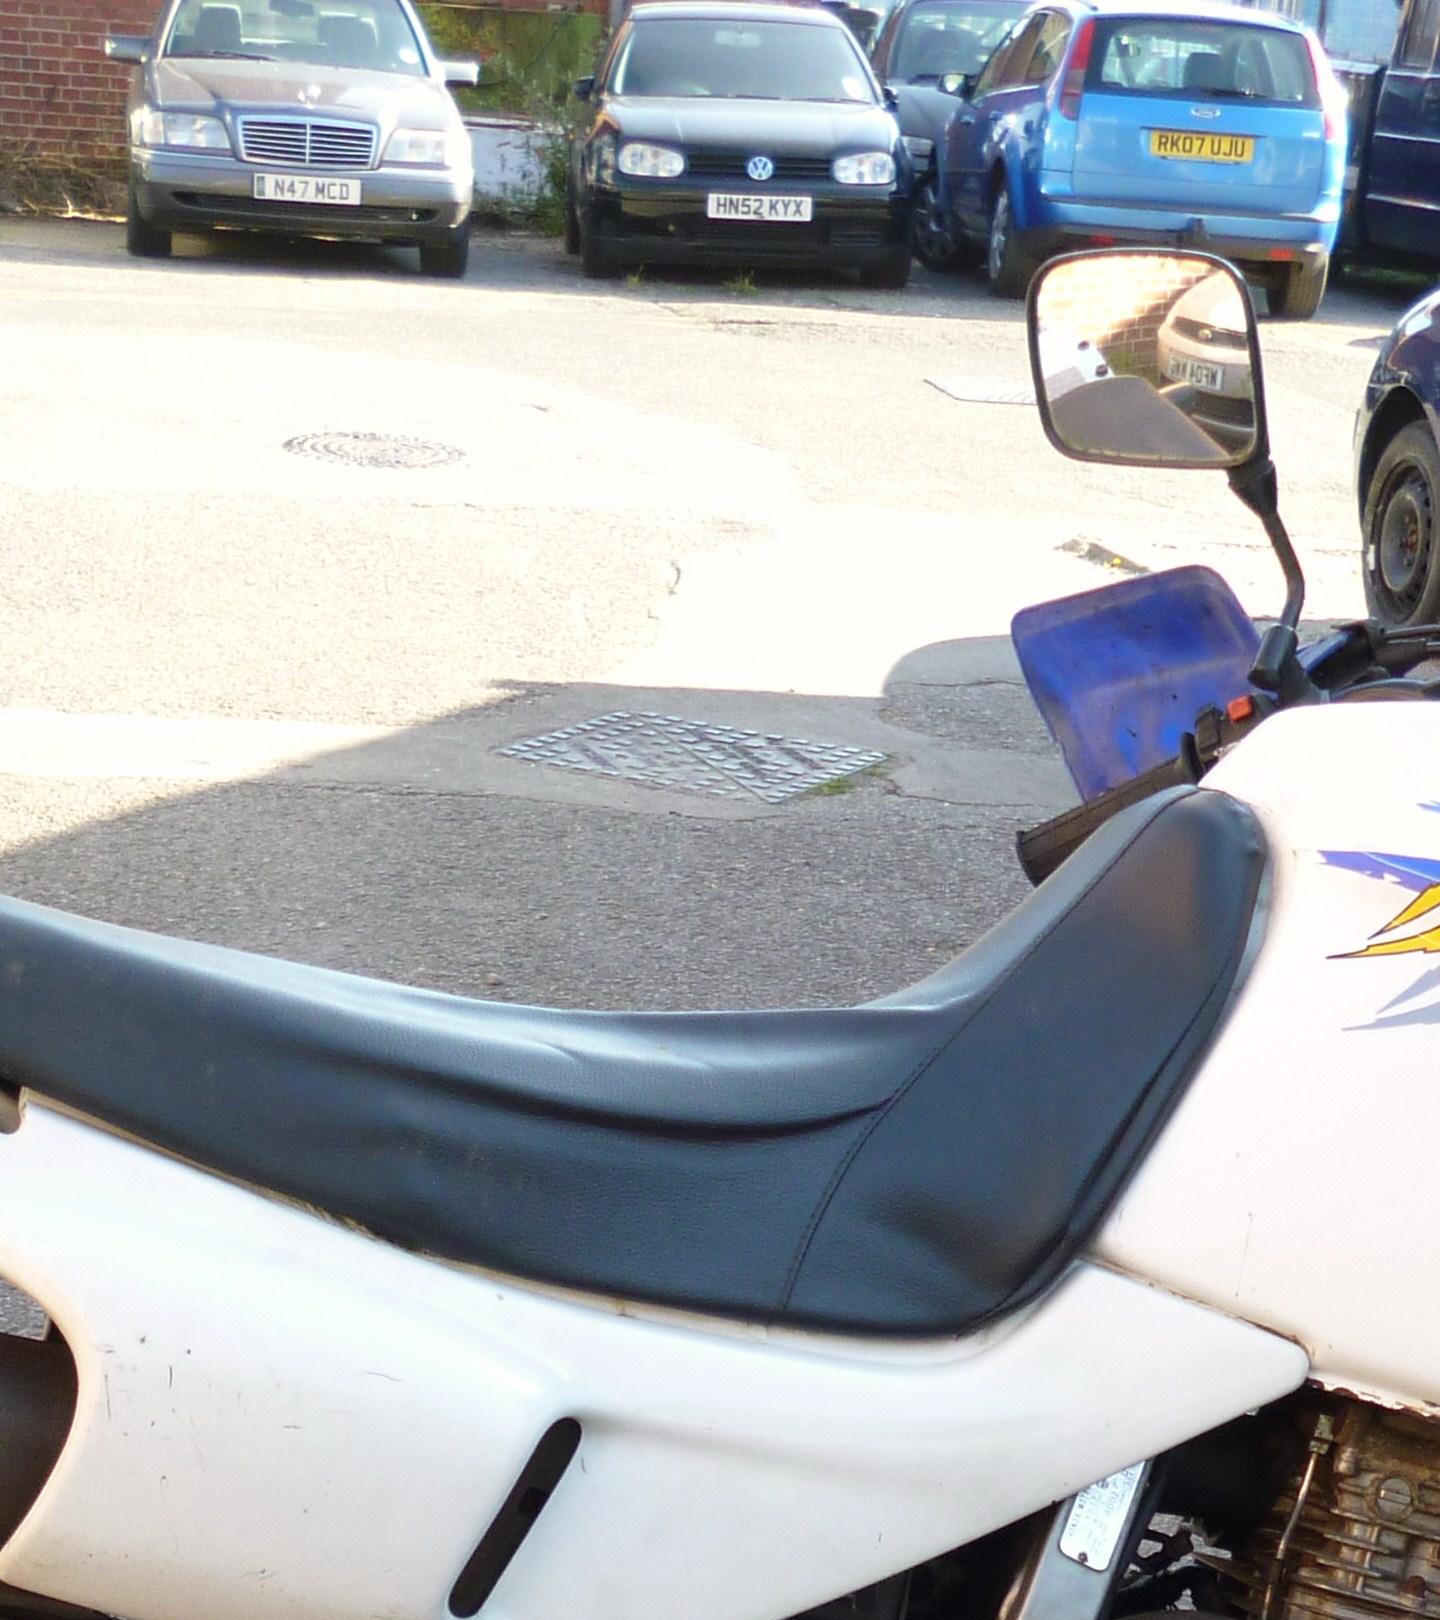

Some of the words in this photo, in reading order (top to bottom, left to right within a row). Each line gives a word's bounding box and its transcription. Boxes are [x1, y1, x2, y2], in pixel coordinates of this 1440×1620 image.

[1157, 133, 1205, 154] RK07
[1210, 138, 1246, 158] UJU
[274, 178, 309, 198] N47
[314, 181, 349, 200] MCD
[716, 196, 764, 216] HN52
[768, 199, 804, 218] KYX
